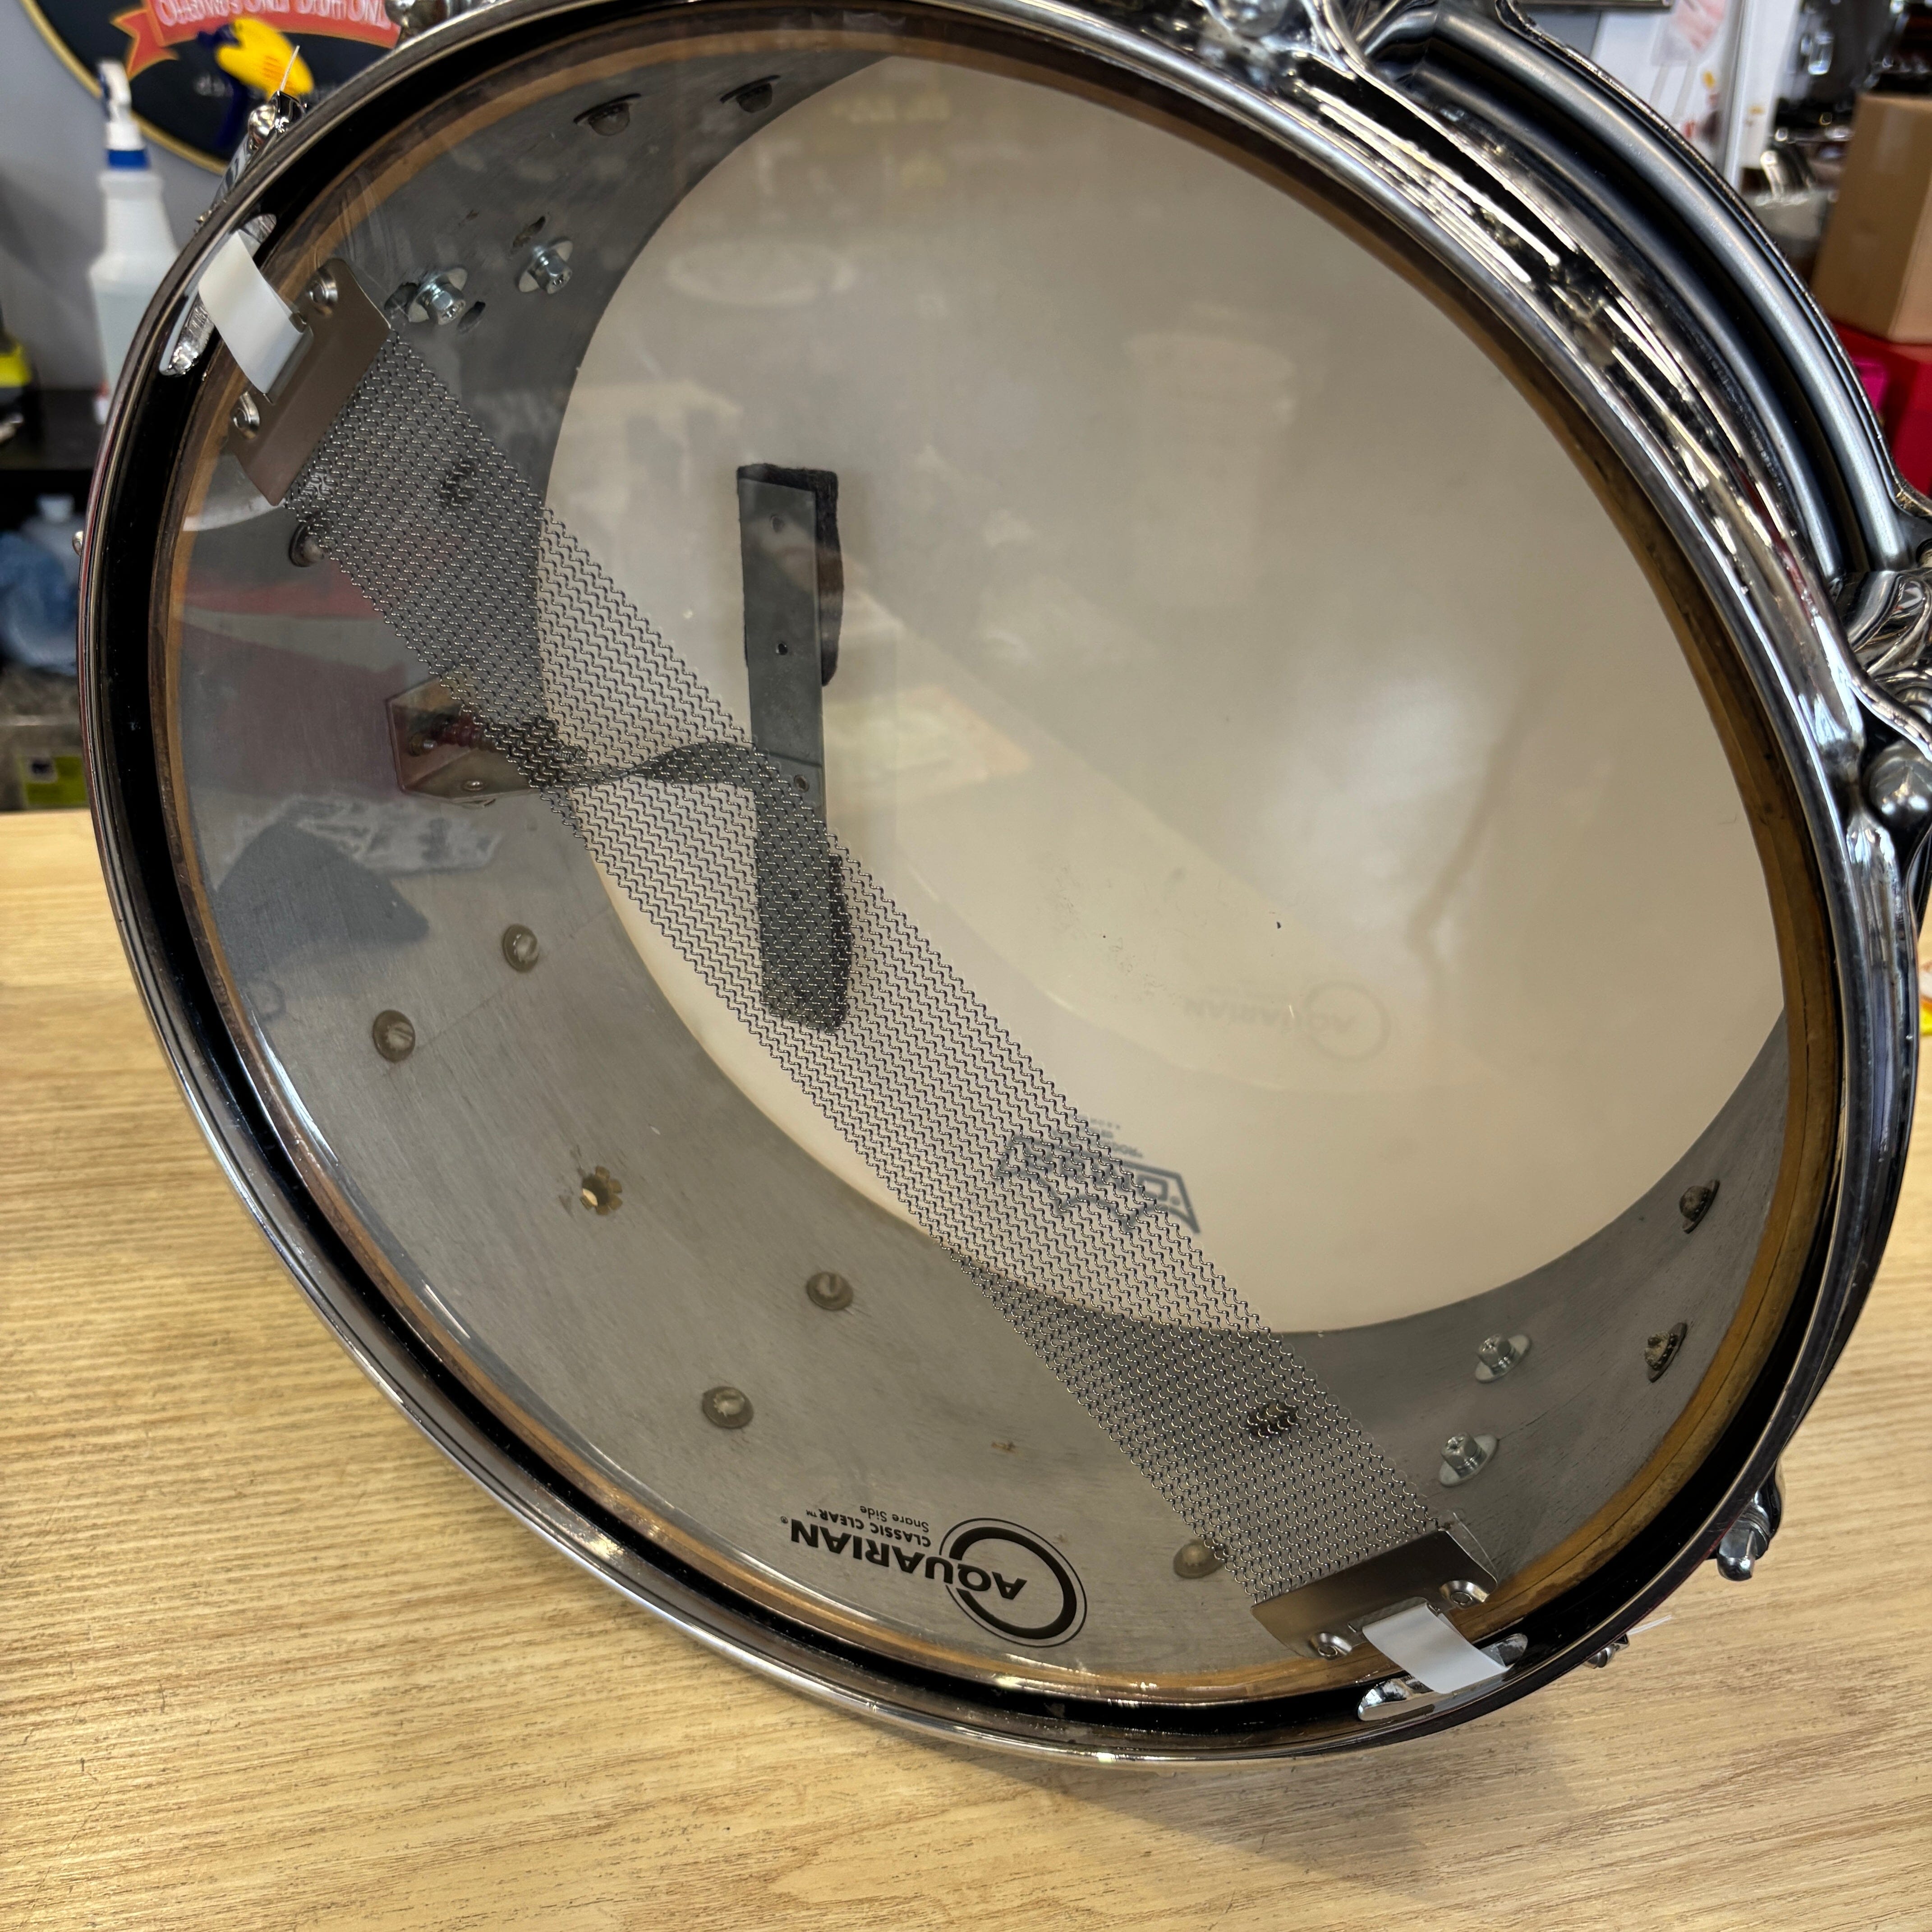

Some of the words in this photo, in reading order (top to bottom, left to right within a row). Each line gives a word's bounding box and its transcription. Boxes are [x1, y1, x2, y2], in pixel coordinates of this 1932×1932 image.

[860, 1505, 888, 1523] Side
[892, 1513, 929, 1533] Snare
[870, 1522, 931, 1548] CLASSIC
